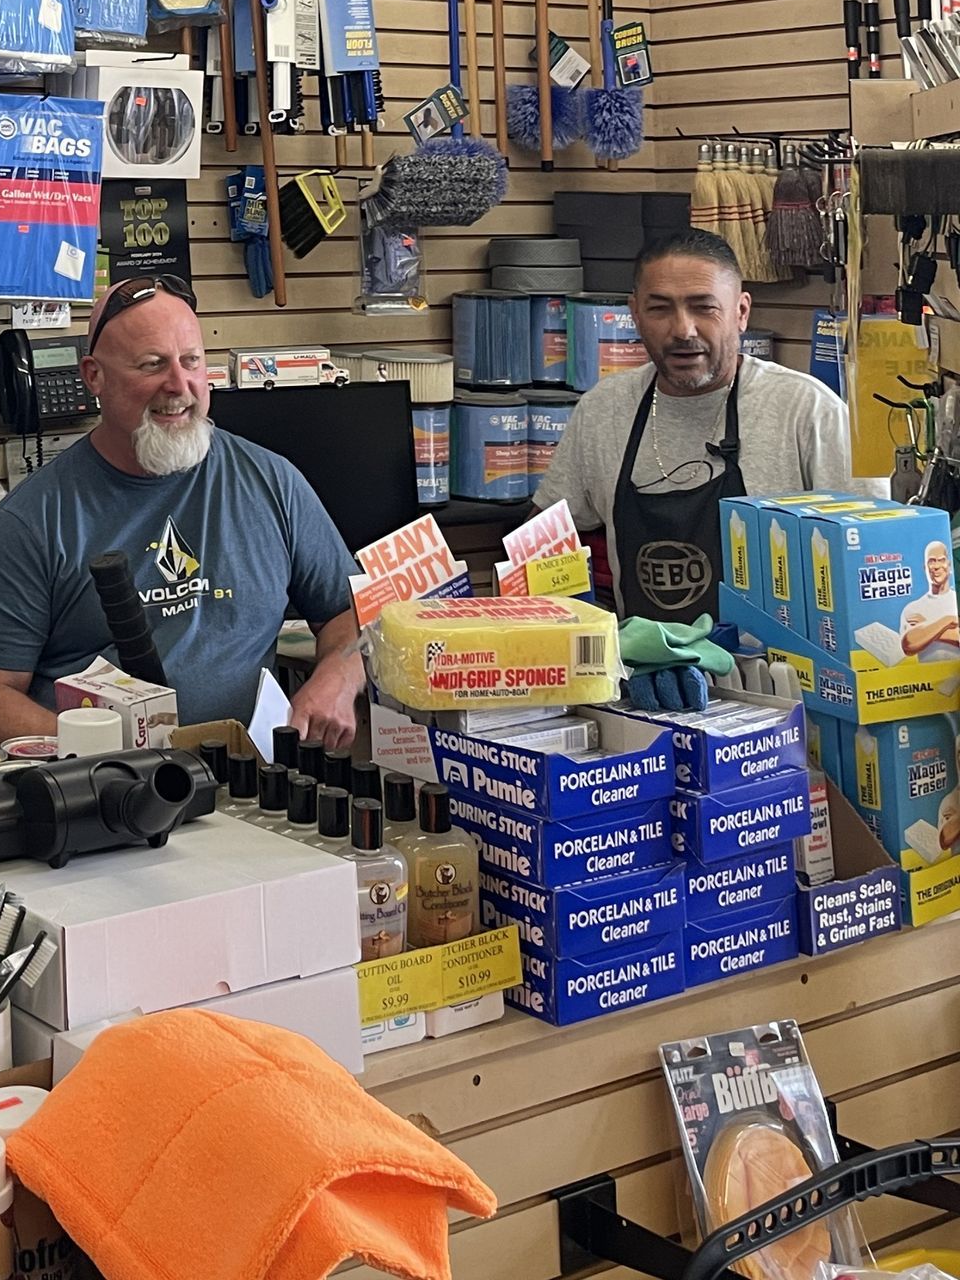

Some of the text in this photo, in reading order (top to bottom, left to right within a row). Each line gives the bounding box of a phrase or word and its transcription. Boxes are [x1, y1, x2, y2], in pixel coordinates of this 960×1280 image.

[615, 35, 643, 49] BRUSH
[20, 118, 63, 136] VAC
[31, 136, 91, 156] BAGS
[1, 189, 32, 198] Gallon
[34, 190, 70, 201] Wet/Dry
[73, 194, 92, 203] Vacs
[120, 199, 168, 221] TOP
[123, 222, 169, 247] 100
[846, 528, 859, 545] 6
[361, 518, 438, 580] HEAVY
[391, 547, 453, 601] DUTY
[640, 560, 705, 587] SEBO
[859, 566, 911, 584] Magic
[214, 588, 233, 599] 91
[860, 582, 912, 600] Eraser
[162, 598, 199, 617] MAUI
[866, 682, 934, 701] THE ORIGINAL
[716, 726, 800, 764] PORCELAIN & TILE
[898, 726, 909, 743] 6
[435, 731, 538, 777] SCOURING STICK
[559, 754, 667, 792] PORCELAIN & TILE
[741, 755, 779, 778] Cleaner
[909, 757, 946, 782] Magic
[472, 767, 536, 809] Pumie
[592, 784, 639, 805] Cleaner
[909, 777, 947, 799] Eraser
[710, 795, 804, 834] PORCELAIN & TILE
[554, 821, 663, 859] PORCELAIN & TILE
[738, 825, 781, 848] Cleaner
[586, 852, 635, 873] Cleaner
[689, 856, 788, 894] PORCELAIN & TILE
[718, 884, 763, 907] Cleaner
[814, 878, 896, 912] Cleans Scale,
[569, 888, 678, 930] PORCELAIN & TILE
[819, 897, 892, 928] Rust, Stains
[601, 920, 650, 943] Cleaner
[690, 919, 790, 961] PORCELAIN & TILE
[817, 912, 896, 947] & Grime Fast
[357, 954, 433, 979] CUTTING BOARD
[720, 950, 765, 973] Cleaner
[387, 974, 403, 986] OIL
[458, 970, 491, 989] $10.99
[567, 952, 676, 997] PORCELAIN & TILE
[382, 993, 409, 1011] $9.99
[599, 984, 648, 1009] Cleaner
